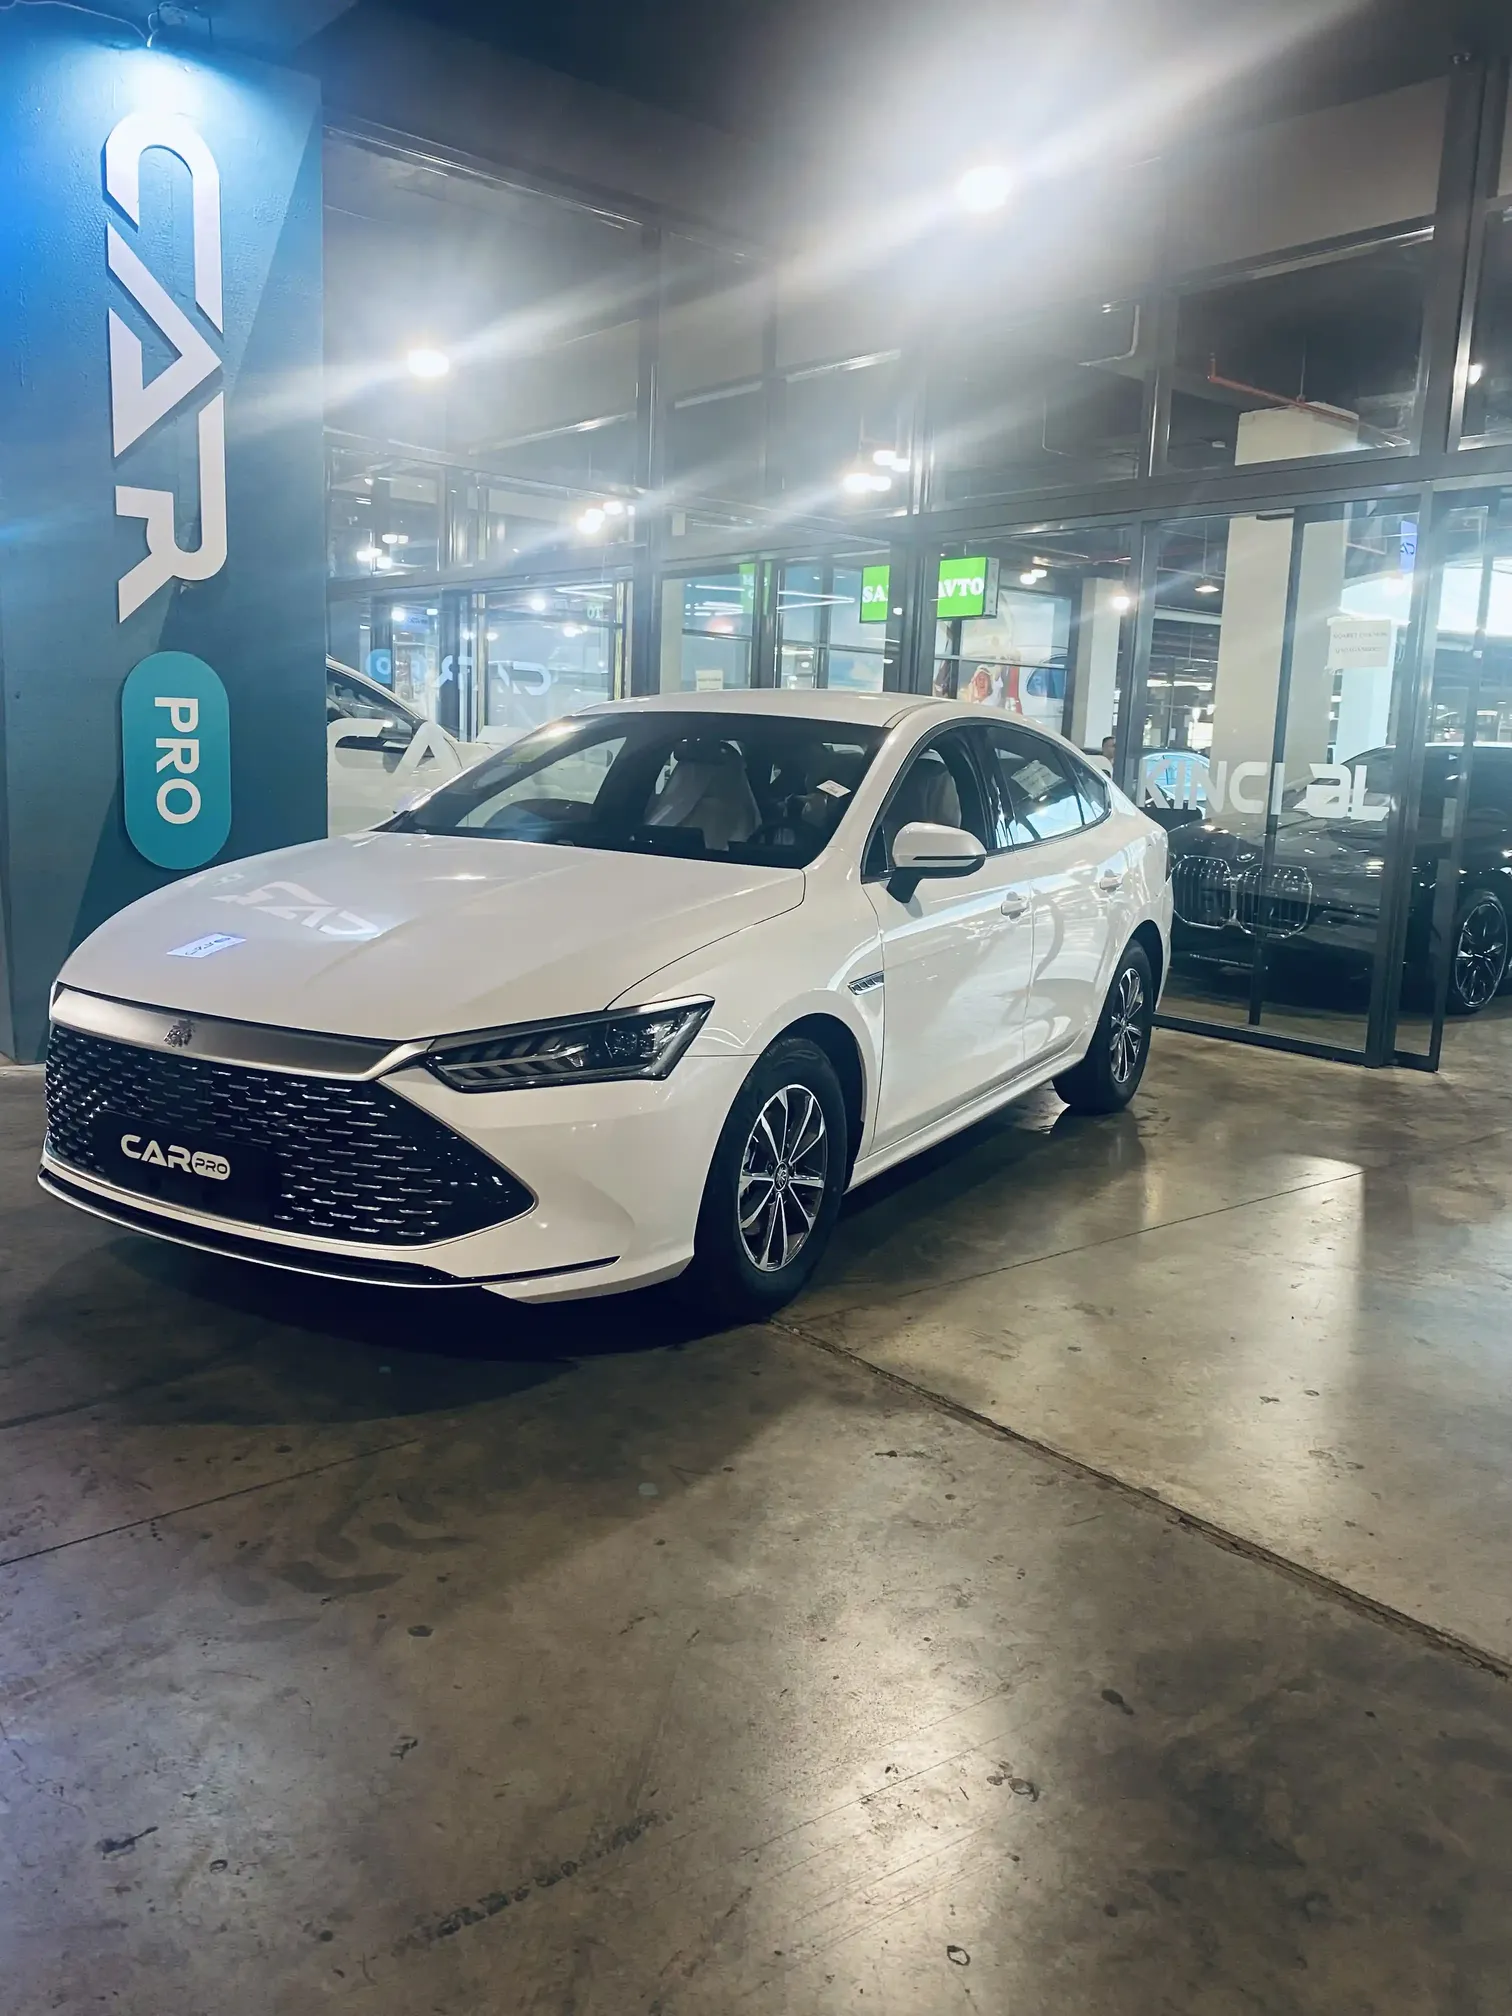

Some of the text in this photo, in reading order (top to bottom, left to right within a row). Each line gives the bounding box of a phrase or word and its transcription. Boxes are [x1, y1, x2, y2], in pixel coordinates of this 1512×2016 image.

[105, 112, 228, 825] CAR PRO
[861, 584, 889, 603] SA
[120, 1133, 229, 1175] CAR PRO
